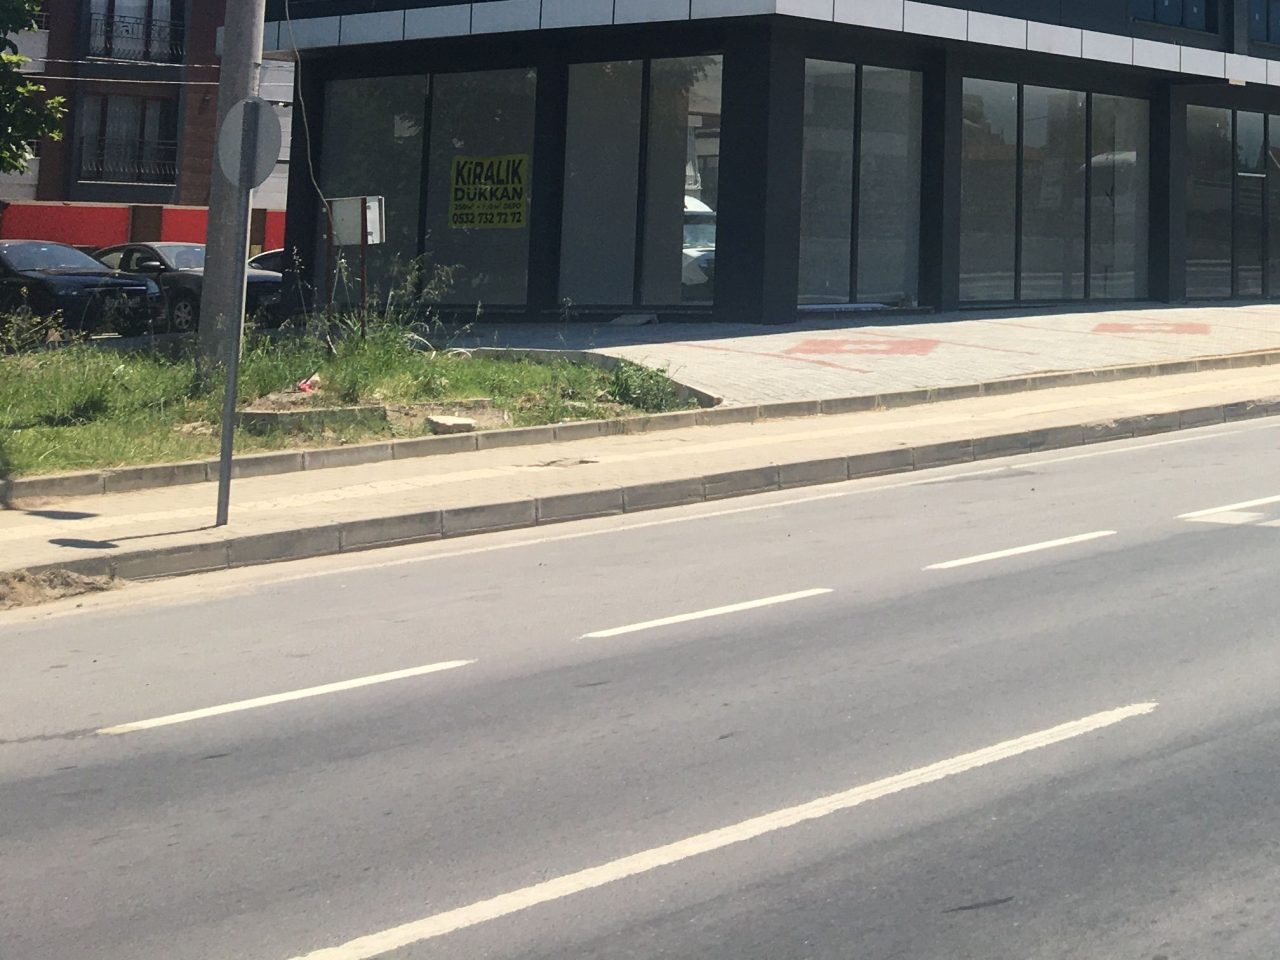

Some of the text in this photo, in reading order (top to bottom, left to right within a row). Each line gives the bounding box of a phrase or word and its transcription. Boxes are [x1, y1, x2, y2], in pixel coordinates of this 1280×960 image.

[452, 211, 522, 224] 0532 732 72 72
